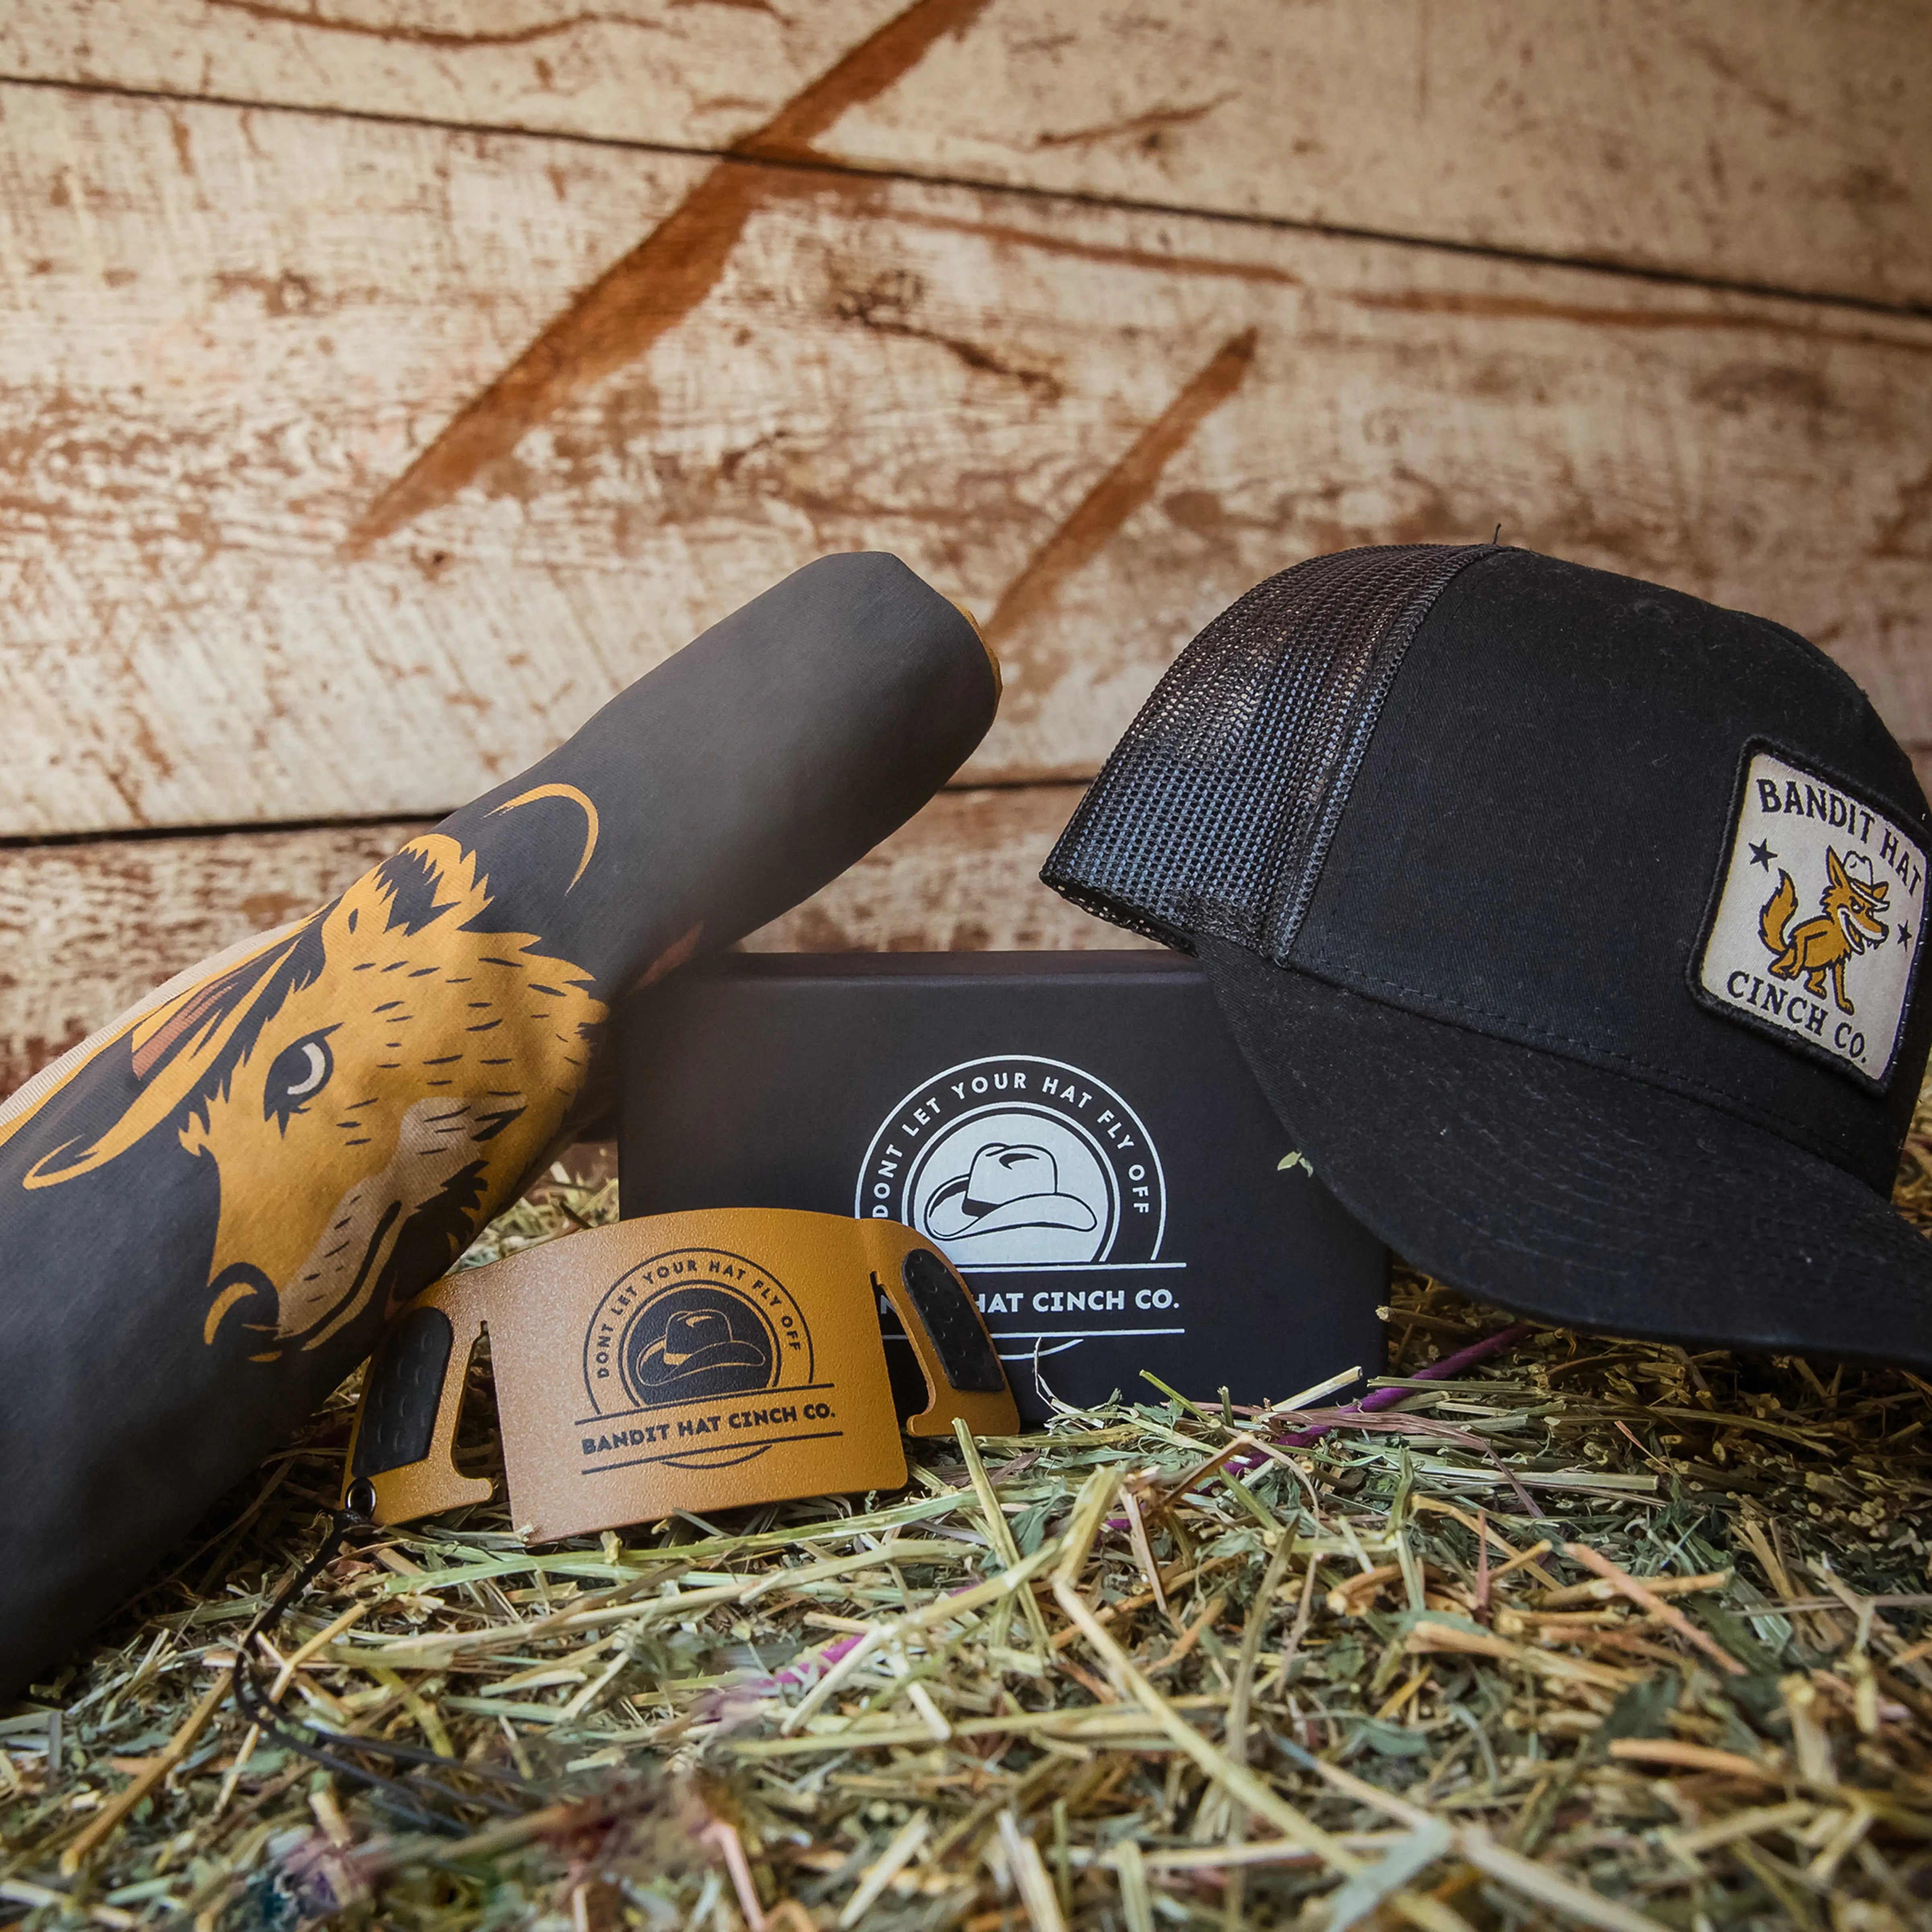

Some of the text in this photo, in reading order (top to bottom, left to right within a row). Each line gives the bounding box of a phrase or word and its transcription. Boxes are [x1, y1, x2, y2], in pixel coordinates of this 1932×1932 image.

[1756, 779, 1922, 896] BANDIT HAT
[1727, 971, 1867, 1063] CINCH CO.
[872, 1073, 1149, 1218] DONT LET YOUR HAT FLY OFF
[596, 1260, 800, 1378] DONT LET YOUR HAT FLY OFF
[1032, 1291, 1124, 1312] CINCH
[1135, 1289, 1179, 1309] CO.
[582, 1403, 835, 1455] BANDIT HAT CINCH CO.
